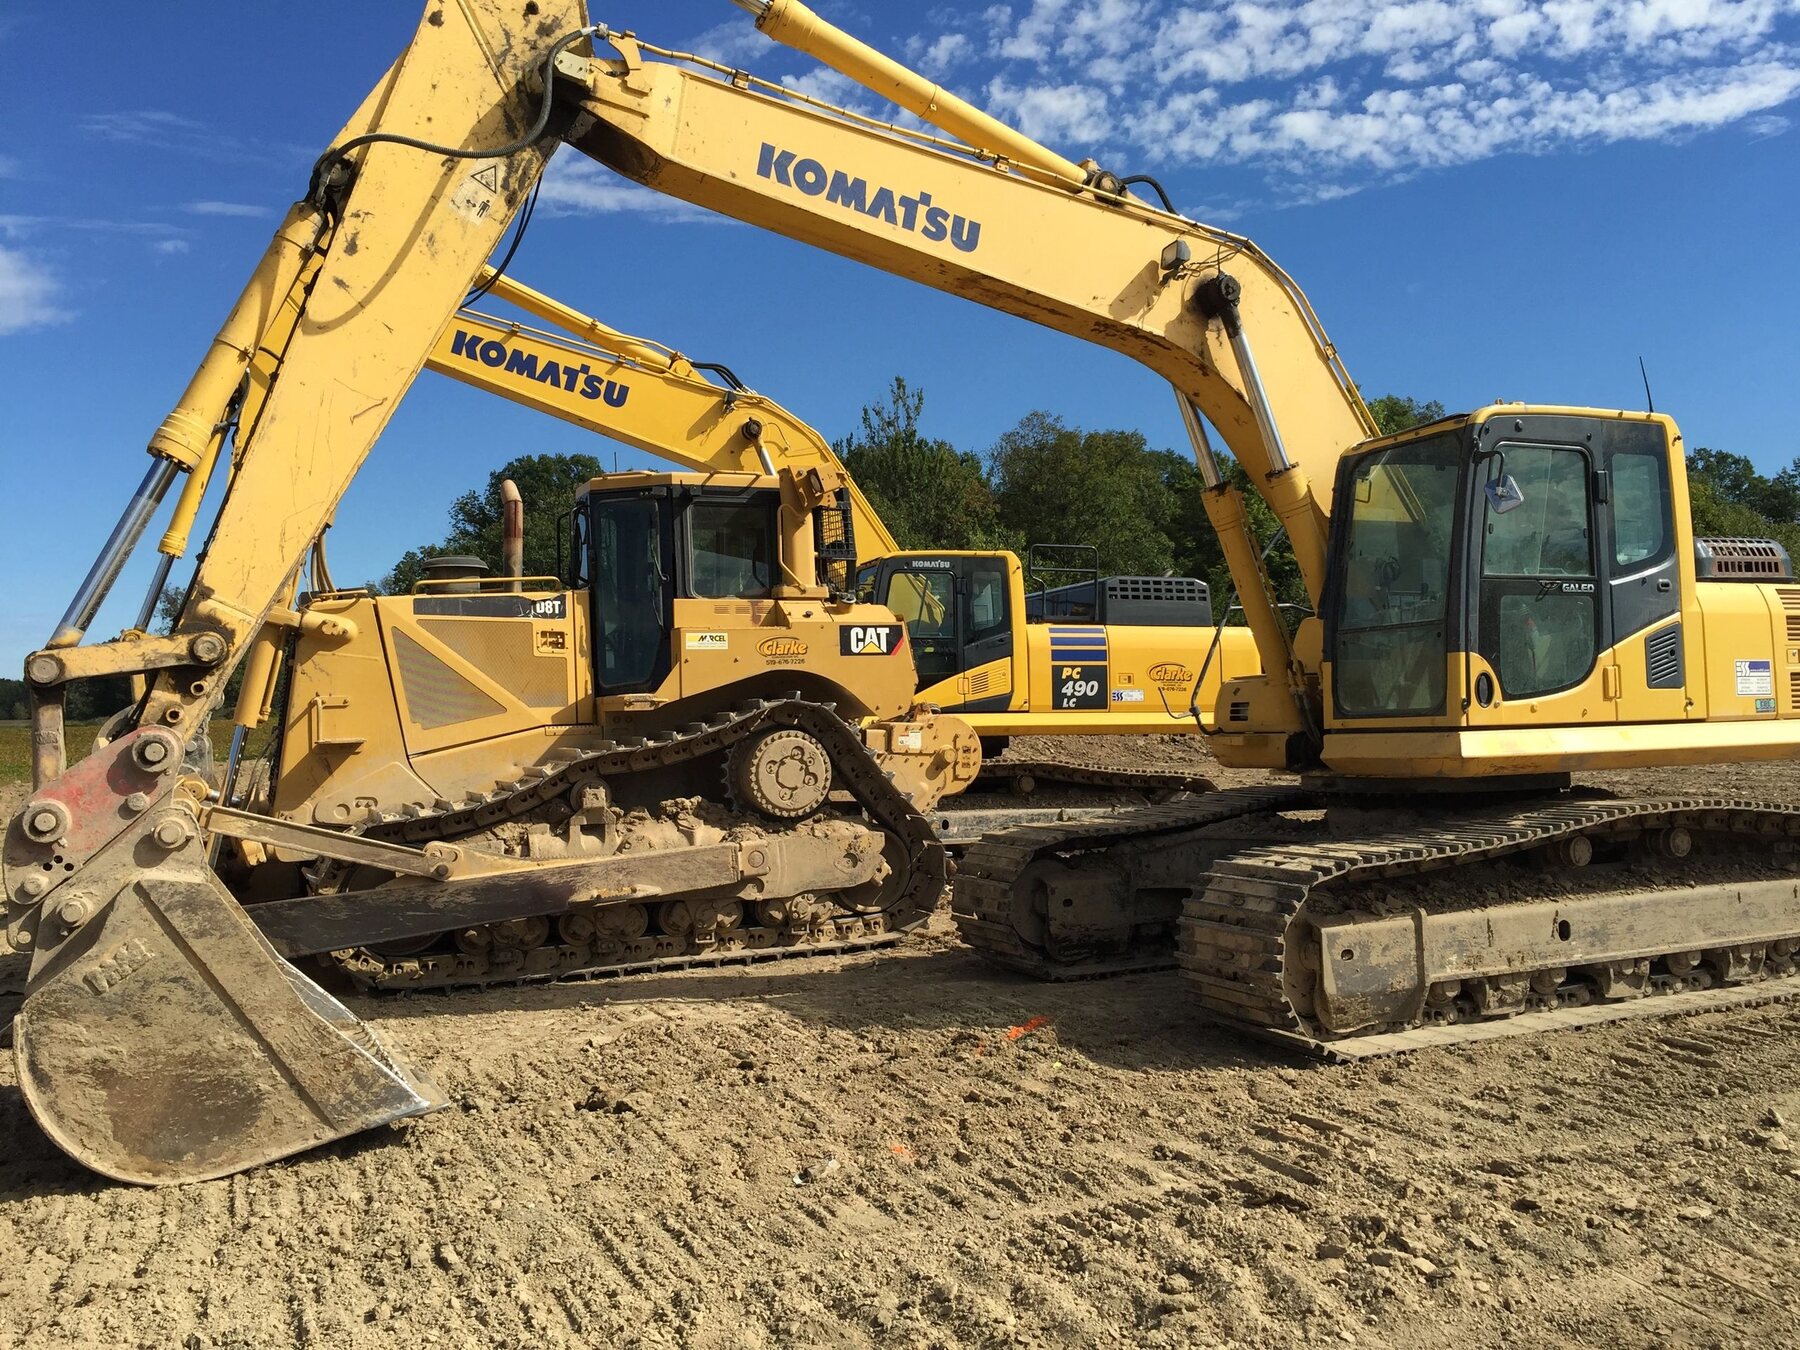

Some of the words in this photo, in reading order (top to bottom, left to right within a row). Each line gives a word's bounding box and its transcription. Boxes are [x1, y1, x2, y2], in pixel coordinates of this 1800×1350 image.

[756, 141, 981, 253] KOMATSU
[450, 330, 630, 408] KOMATSU
[912, 559, 950, 568] KOMATSU
[850, 627, 889, 653] CAT
[764, 641, 808, 656] Clarke
[1061, 667, 1081, 679] PC
[1152, 667, 1193, 681] Clarke
[1061, 680, 1099, 697] 490
[1062, 697, 1077, 708] LC
